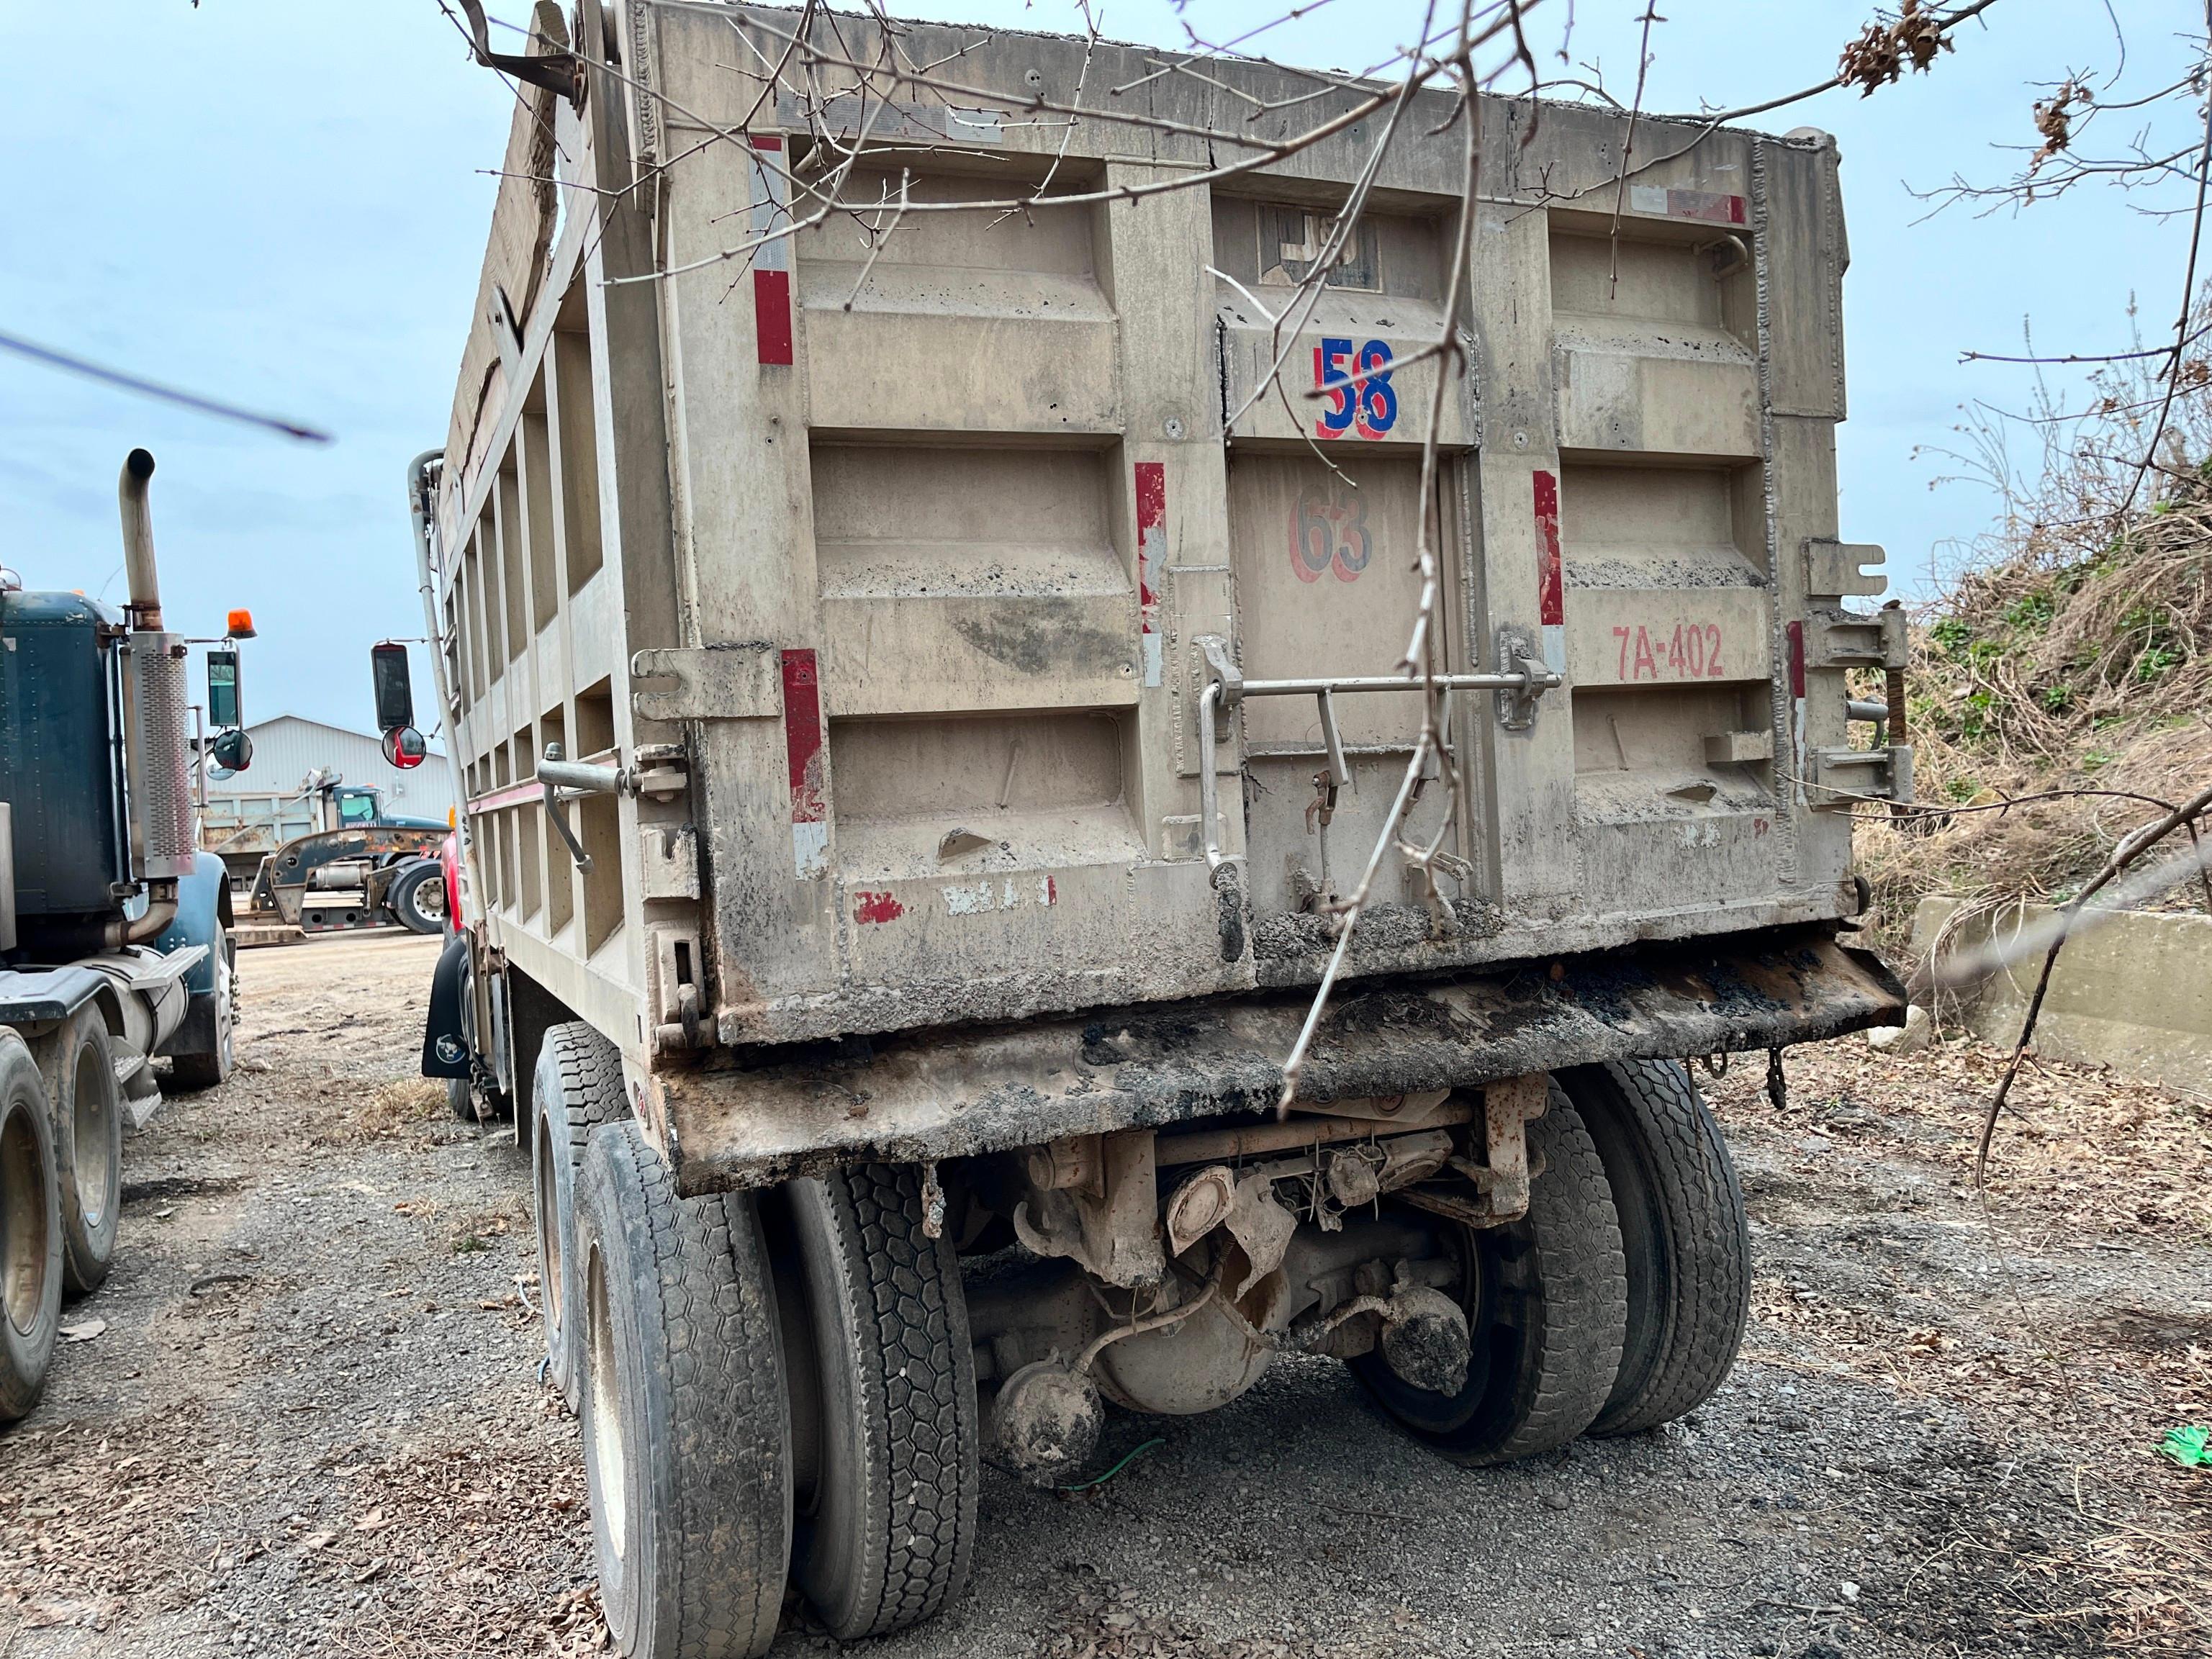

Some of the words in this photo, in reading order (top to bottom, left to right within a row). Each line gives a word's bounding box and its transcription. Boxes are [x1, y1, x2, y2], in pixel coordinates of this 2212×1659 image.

[1312, 338, 1397, 439] 58
[1288, 484, 1373, 583] 63
[1612, 623, 1725, 680] 7A-402
